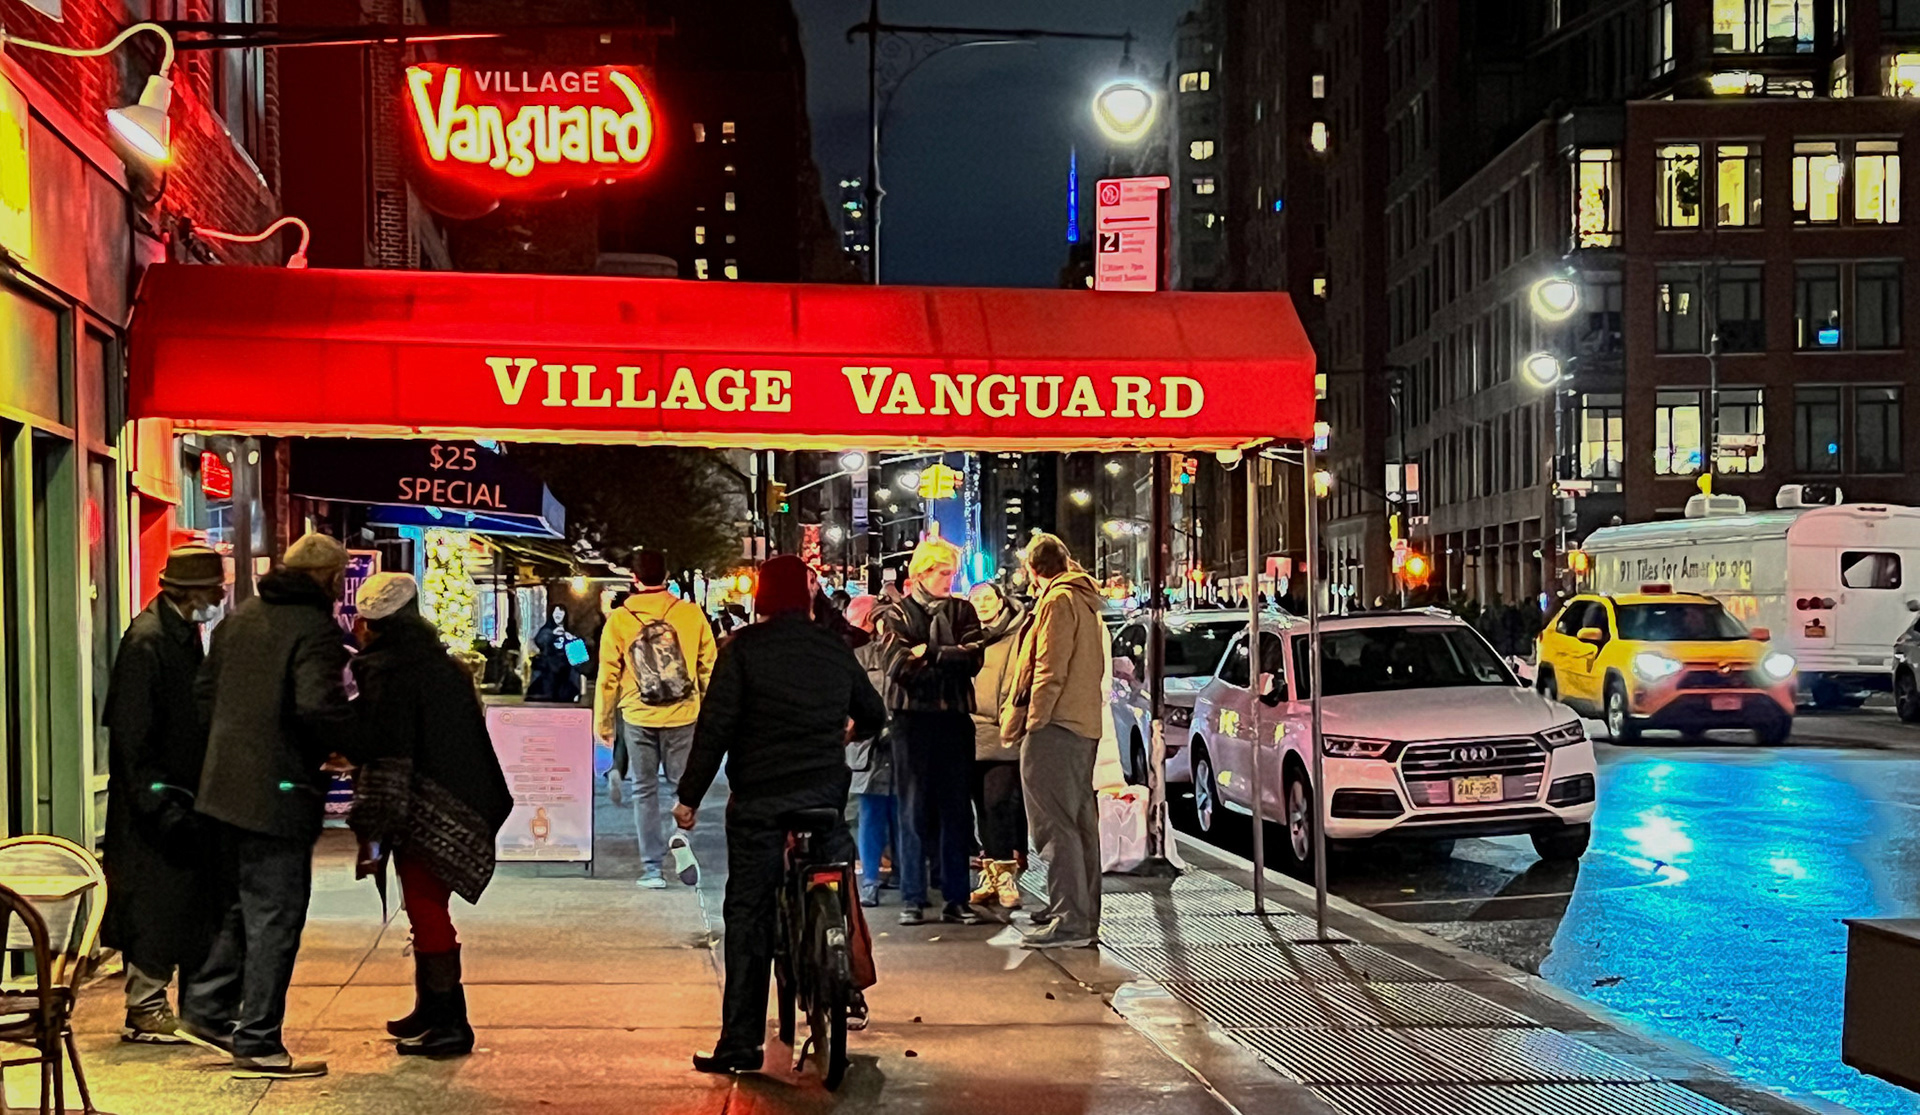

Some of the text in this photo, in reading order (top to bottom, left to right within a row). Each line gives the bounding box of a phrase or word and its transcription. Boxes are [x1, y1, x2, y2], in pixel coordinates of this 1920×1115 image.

[474, 70, 600, 94] VILLAGE
[404, 65, 653, 178] Vanguard
[1103, 231, 1115, 251] 2
[485, 356, 1205, 419] VILLAGE VANGUARD
[429, 443, 478, 472] $25
[398, 476, 508, 509] SPECIAL
